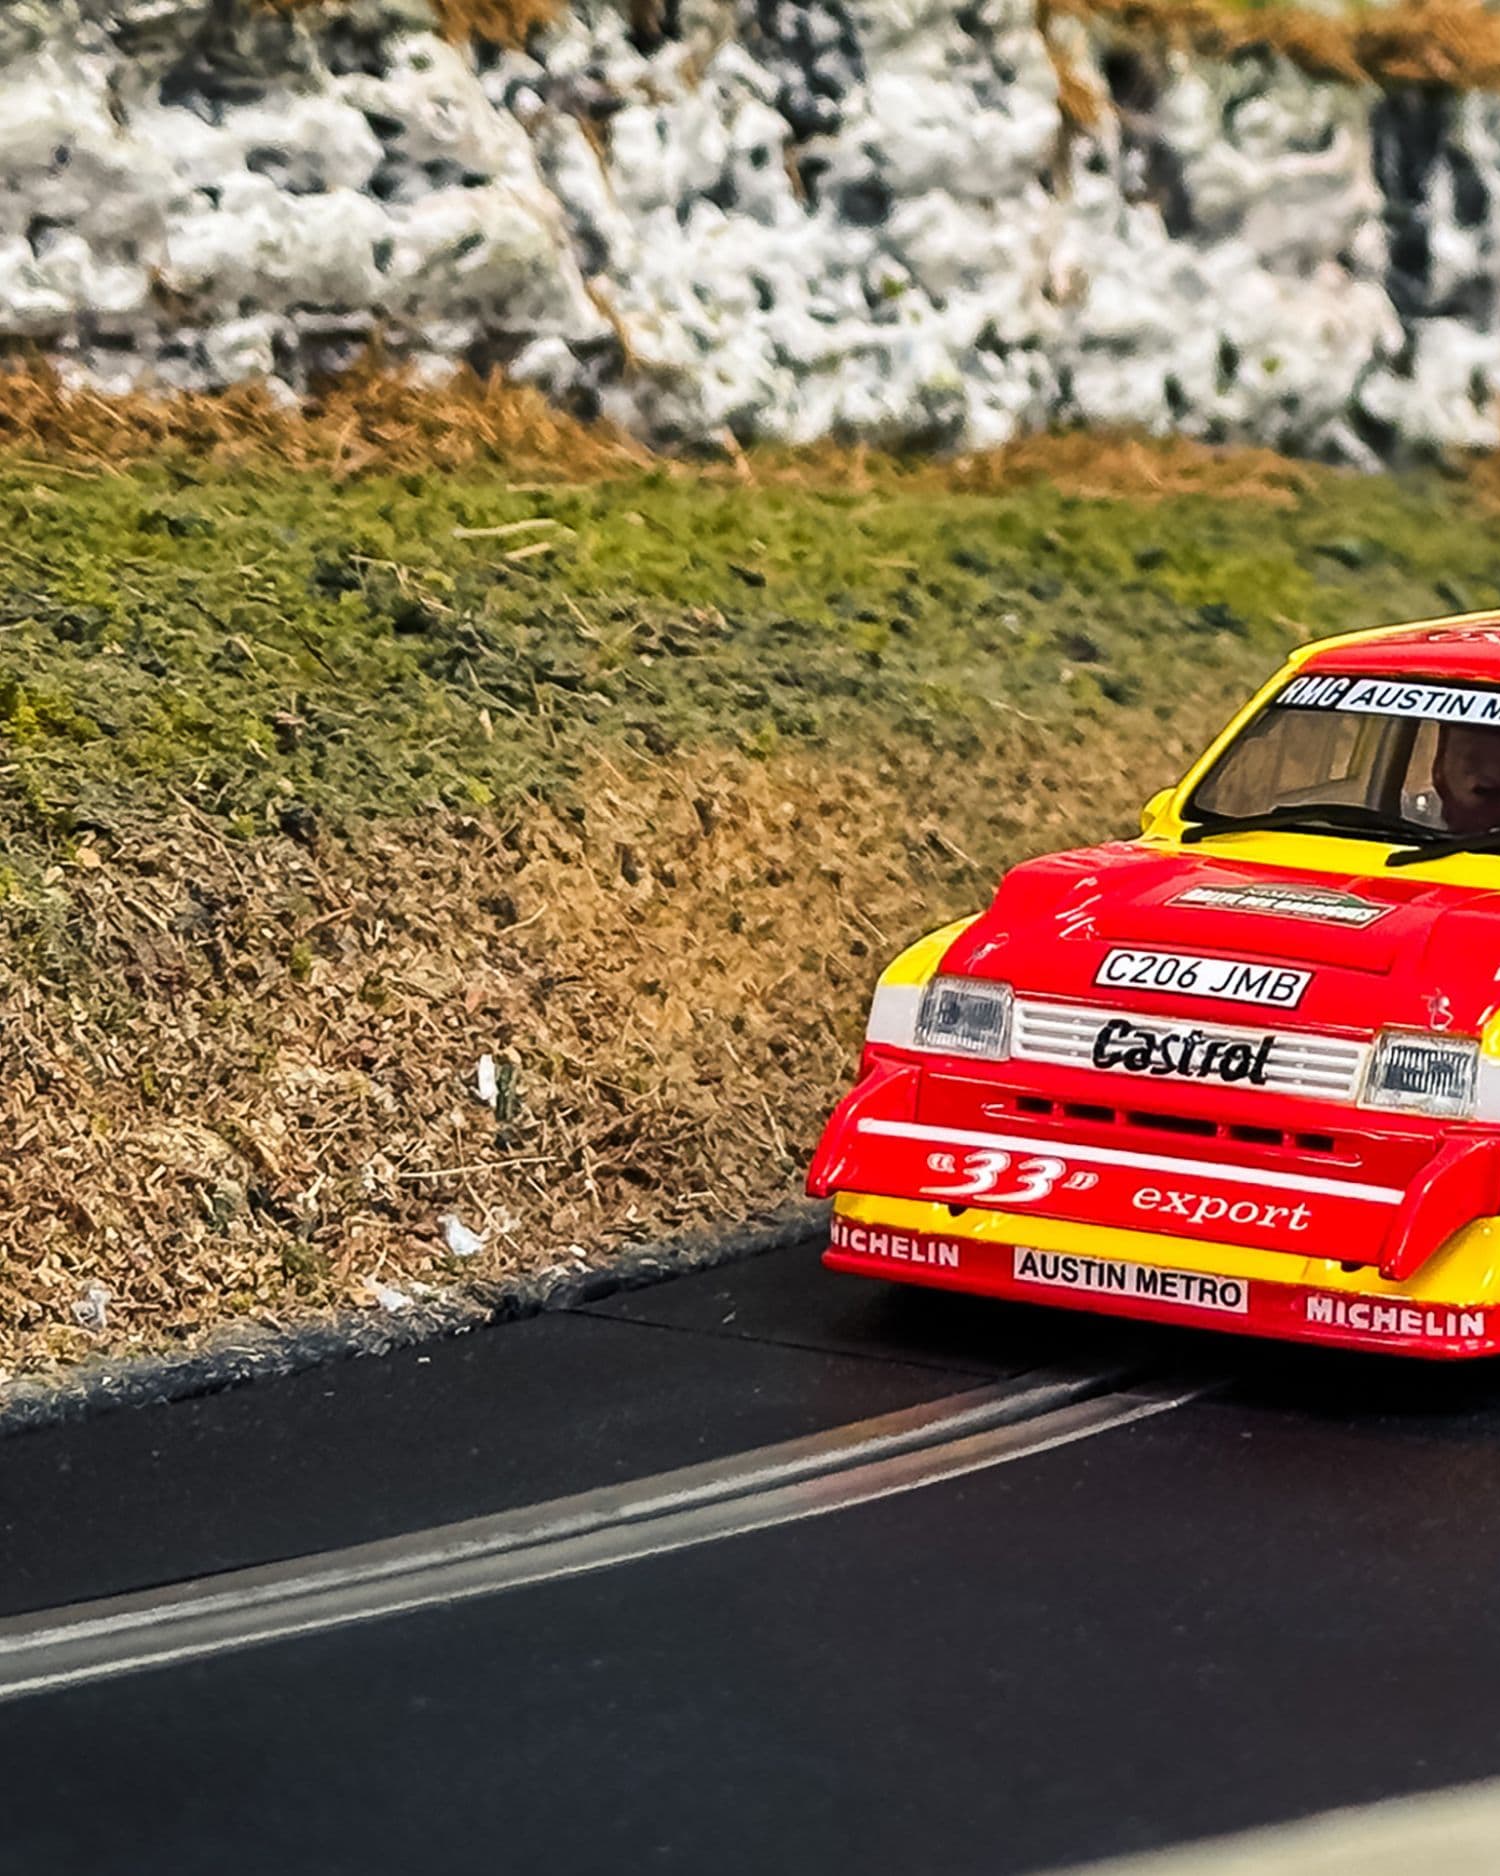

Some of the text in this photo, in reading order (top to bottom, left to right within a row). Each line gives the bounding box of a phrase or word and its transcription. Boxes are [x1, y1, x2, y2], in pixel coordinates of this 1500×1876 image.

[1276, 676, 1350, 706] RMC
[1350, 685, 1470, 716] AUSTIN
[1105, 953, 1301, 1003] C206 JMB
[1092, 1019, 1278, 1086] Castrol
[1131, 1182, 1312, 1232] export
[1018, 1251, 1243, 1309] AUSTIN METRO
[1306, 1298, 1486, 1338] MICHELIN
